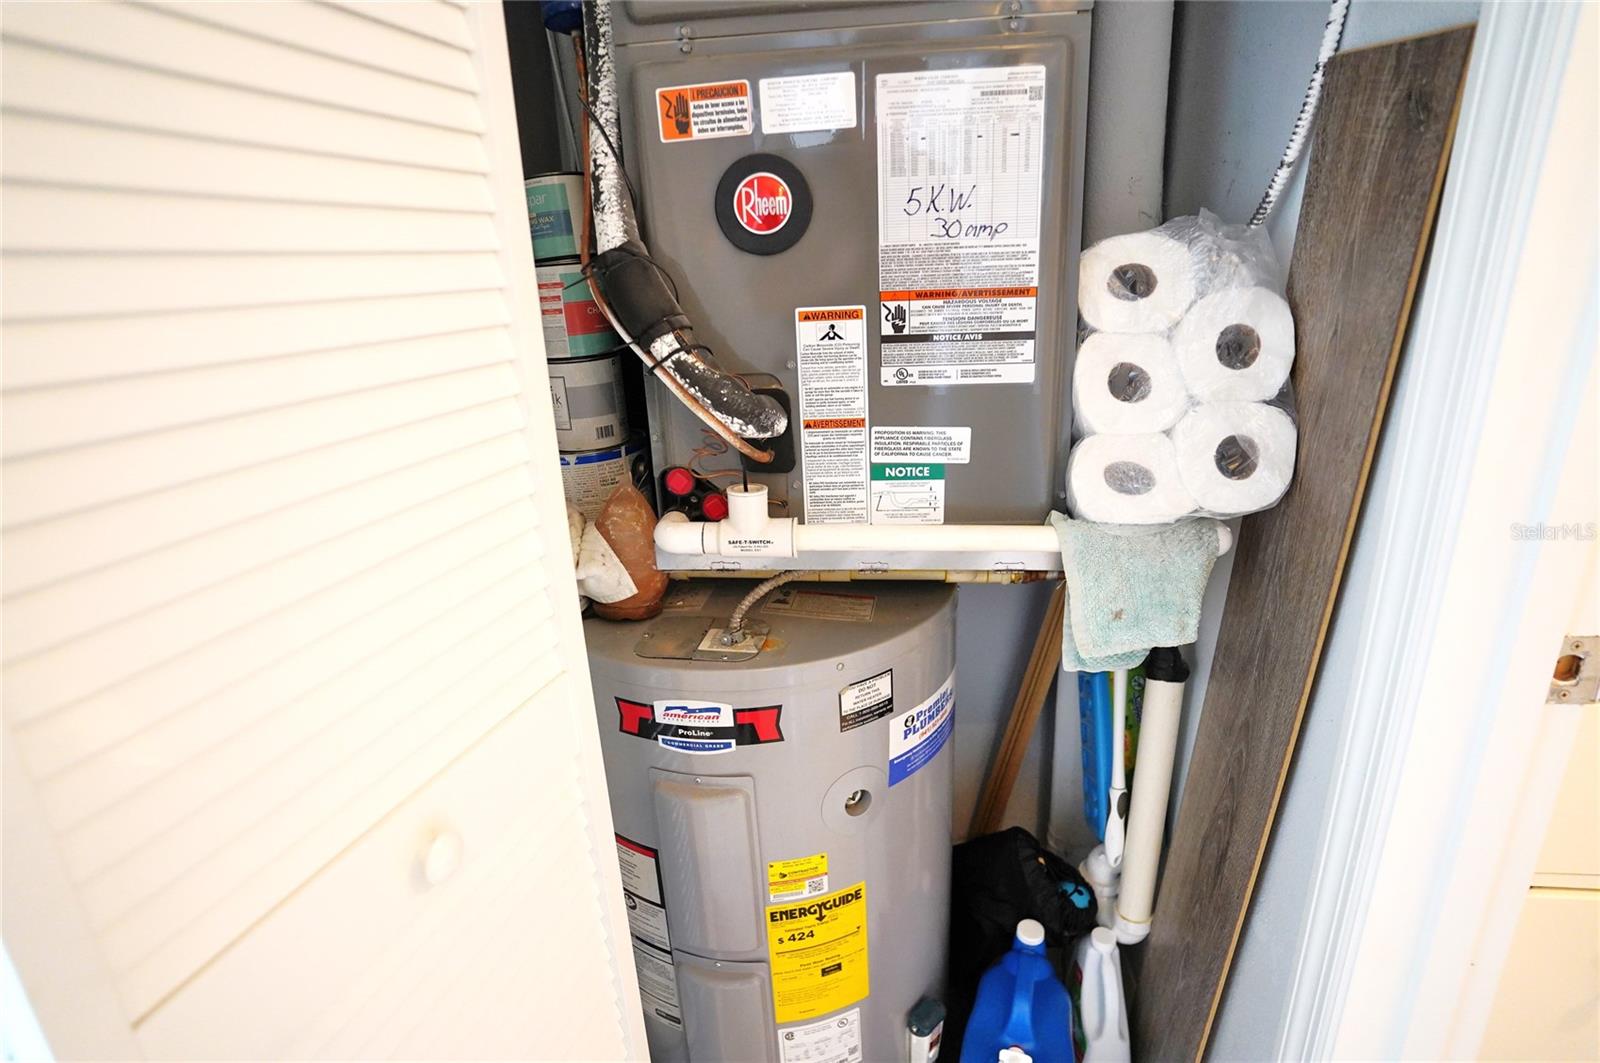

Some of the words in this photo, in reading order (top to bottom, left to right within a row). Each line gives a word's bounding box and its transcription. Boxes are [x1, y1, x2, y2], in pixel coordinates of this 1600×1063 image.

[741, 179, 787, 224] Rheem
[903, 187, 922, 216] 5
[930, 217, 962, 238] 30
[965, 222, 1008, 241] amp
[811, 310, 859, 320] WARNING
[813, 418, 865, 429] AVERTISSEMENT
[885, 466, 930, 477] NOTICE
[663, 712, 720, 720] american
[770, 888, 863, 922] ENERGYGUIDE
[787, 929, 815, 942] 424
